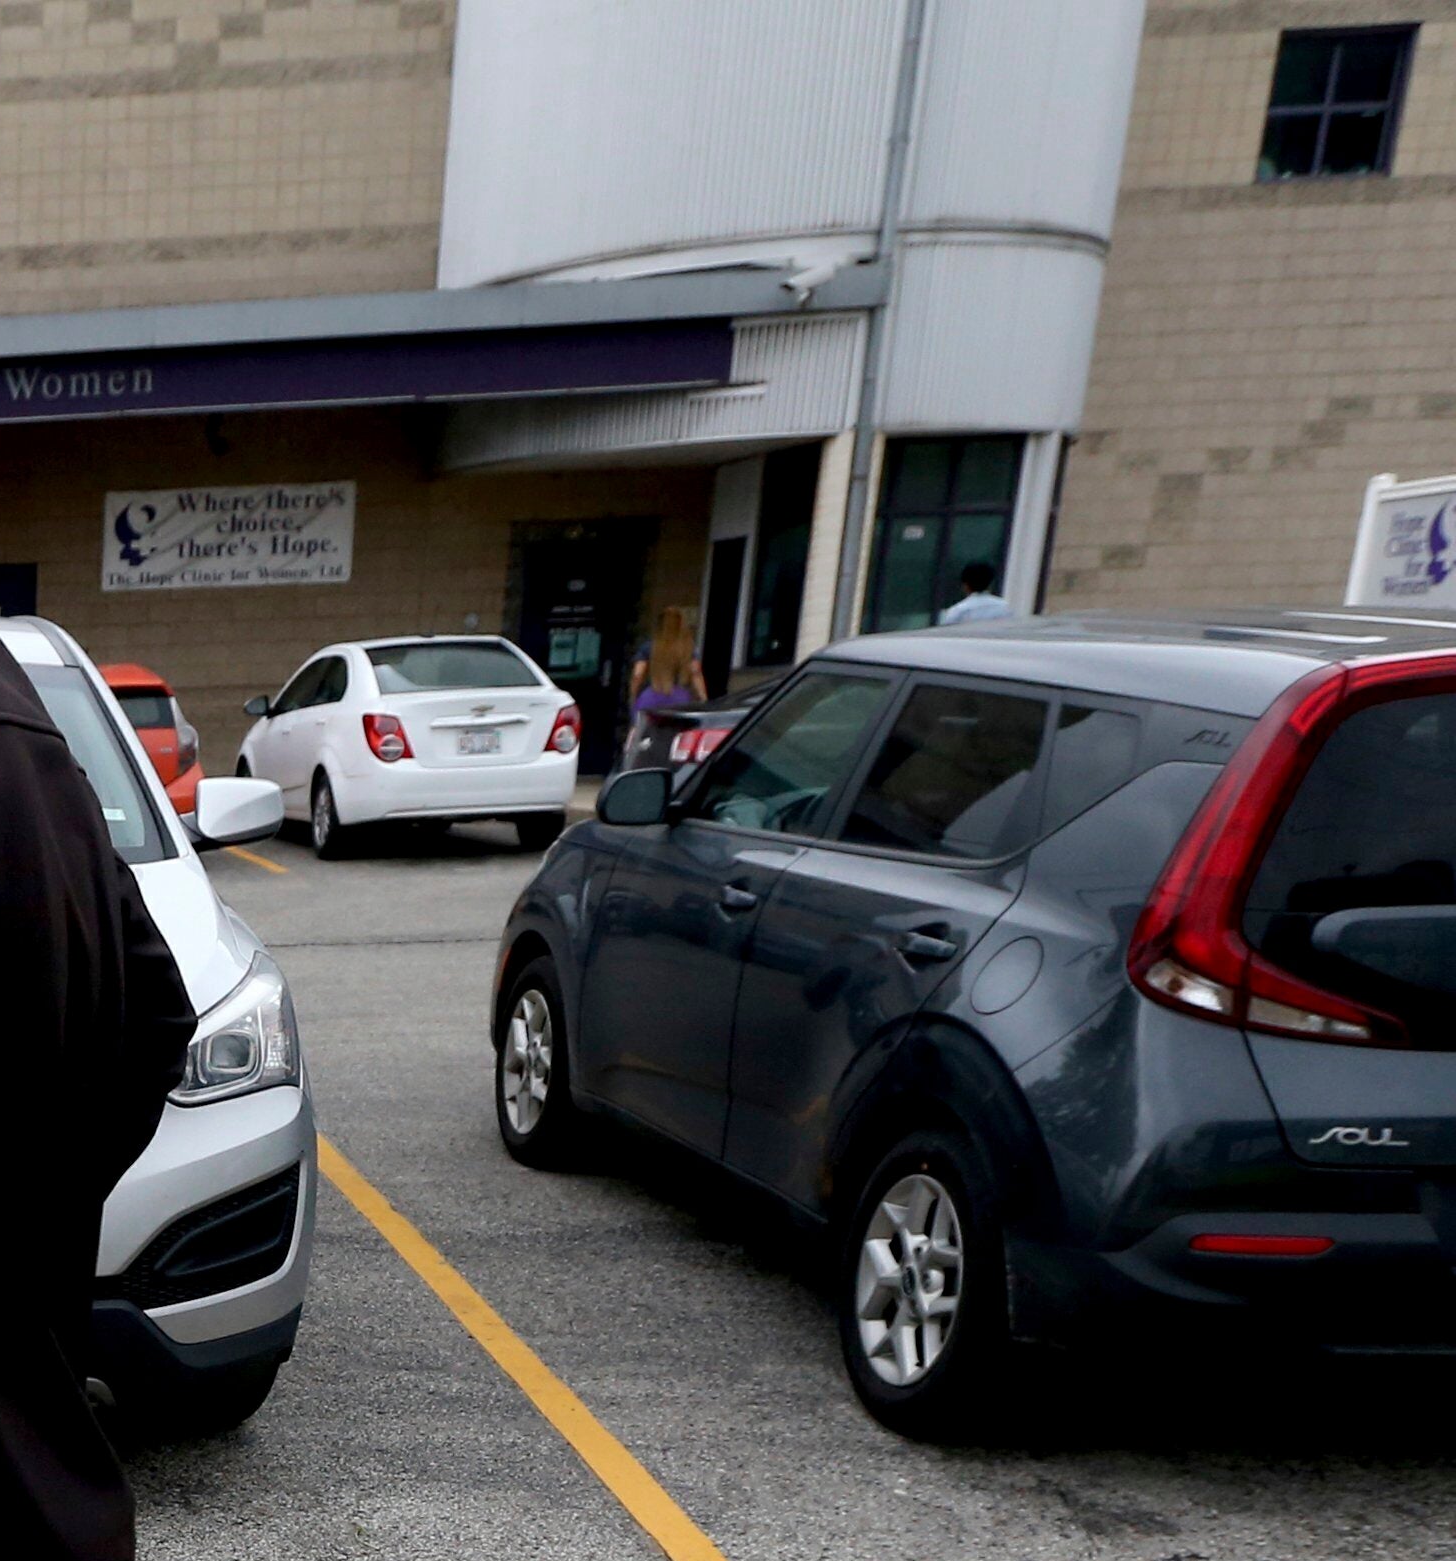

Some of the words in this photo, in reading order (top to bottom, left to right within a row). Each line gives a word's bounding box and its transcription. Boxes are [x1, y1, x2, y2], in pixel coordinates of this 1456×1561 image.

[2, 366, 154, 401] Women
[177, 492, 257, 513] Where
[266, 486, 346, 509] there's
[216, 513, 303, 534] choice,
[178, 538, 257, 558] there's
[271, 535, 338, 557] Hope.
[1308, 1126, 1410, 1146] SOUL
